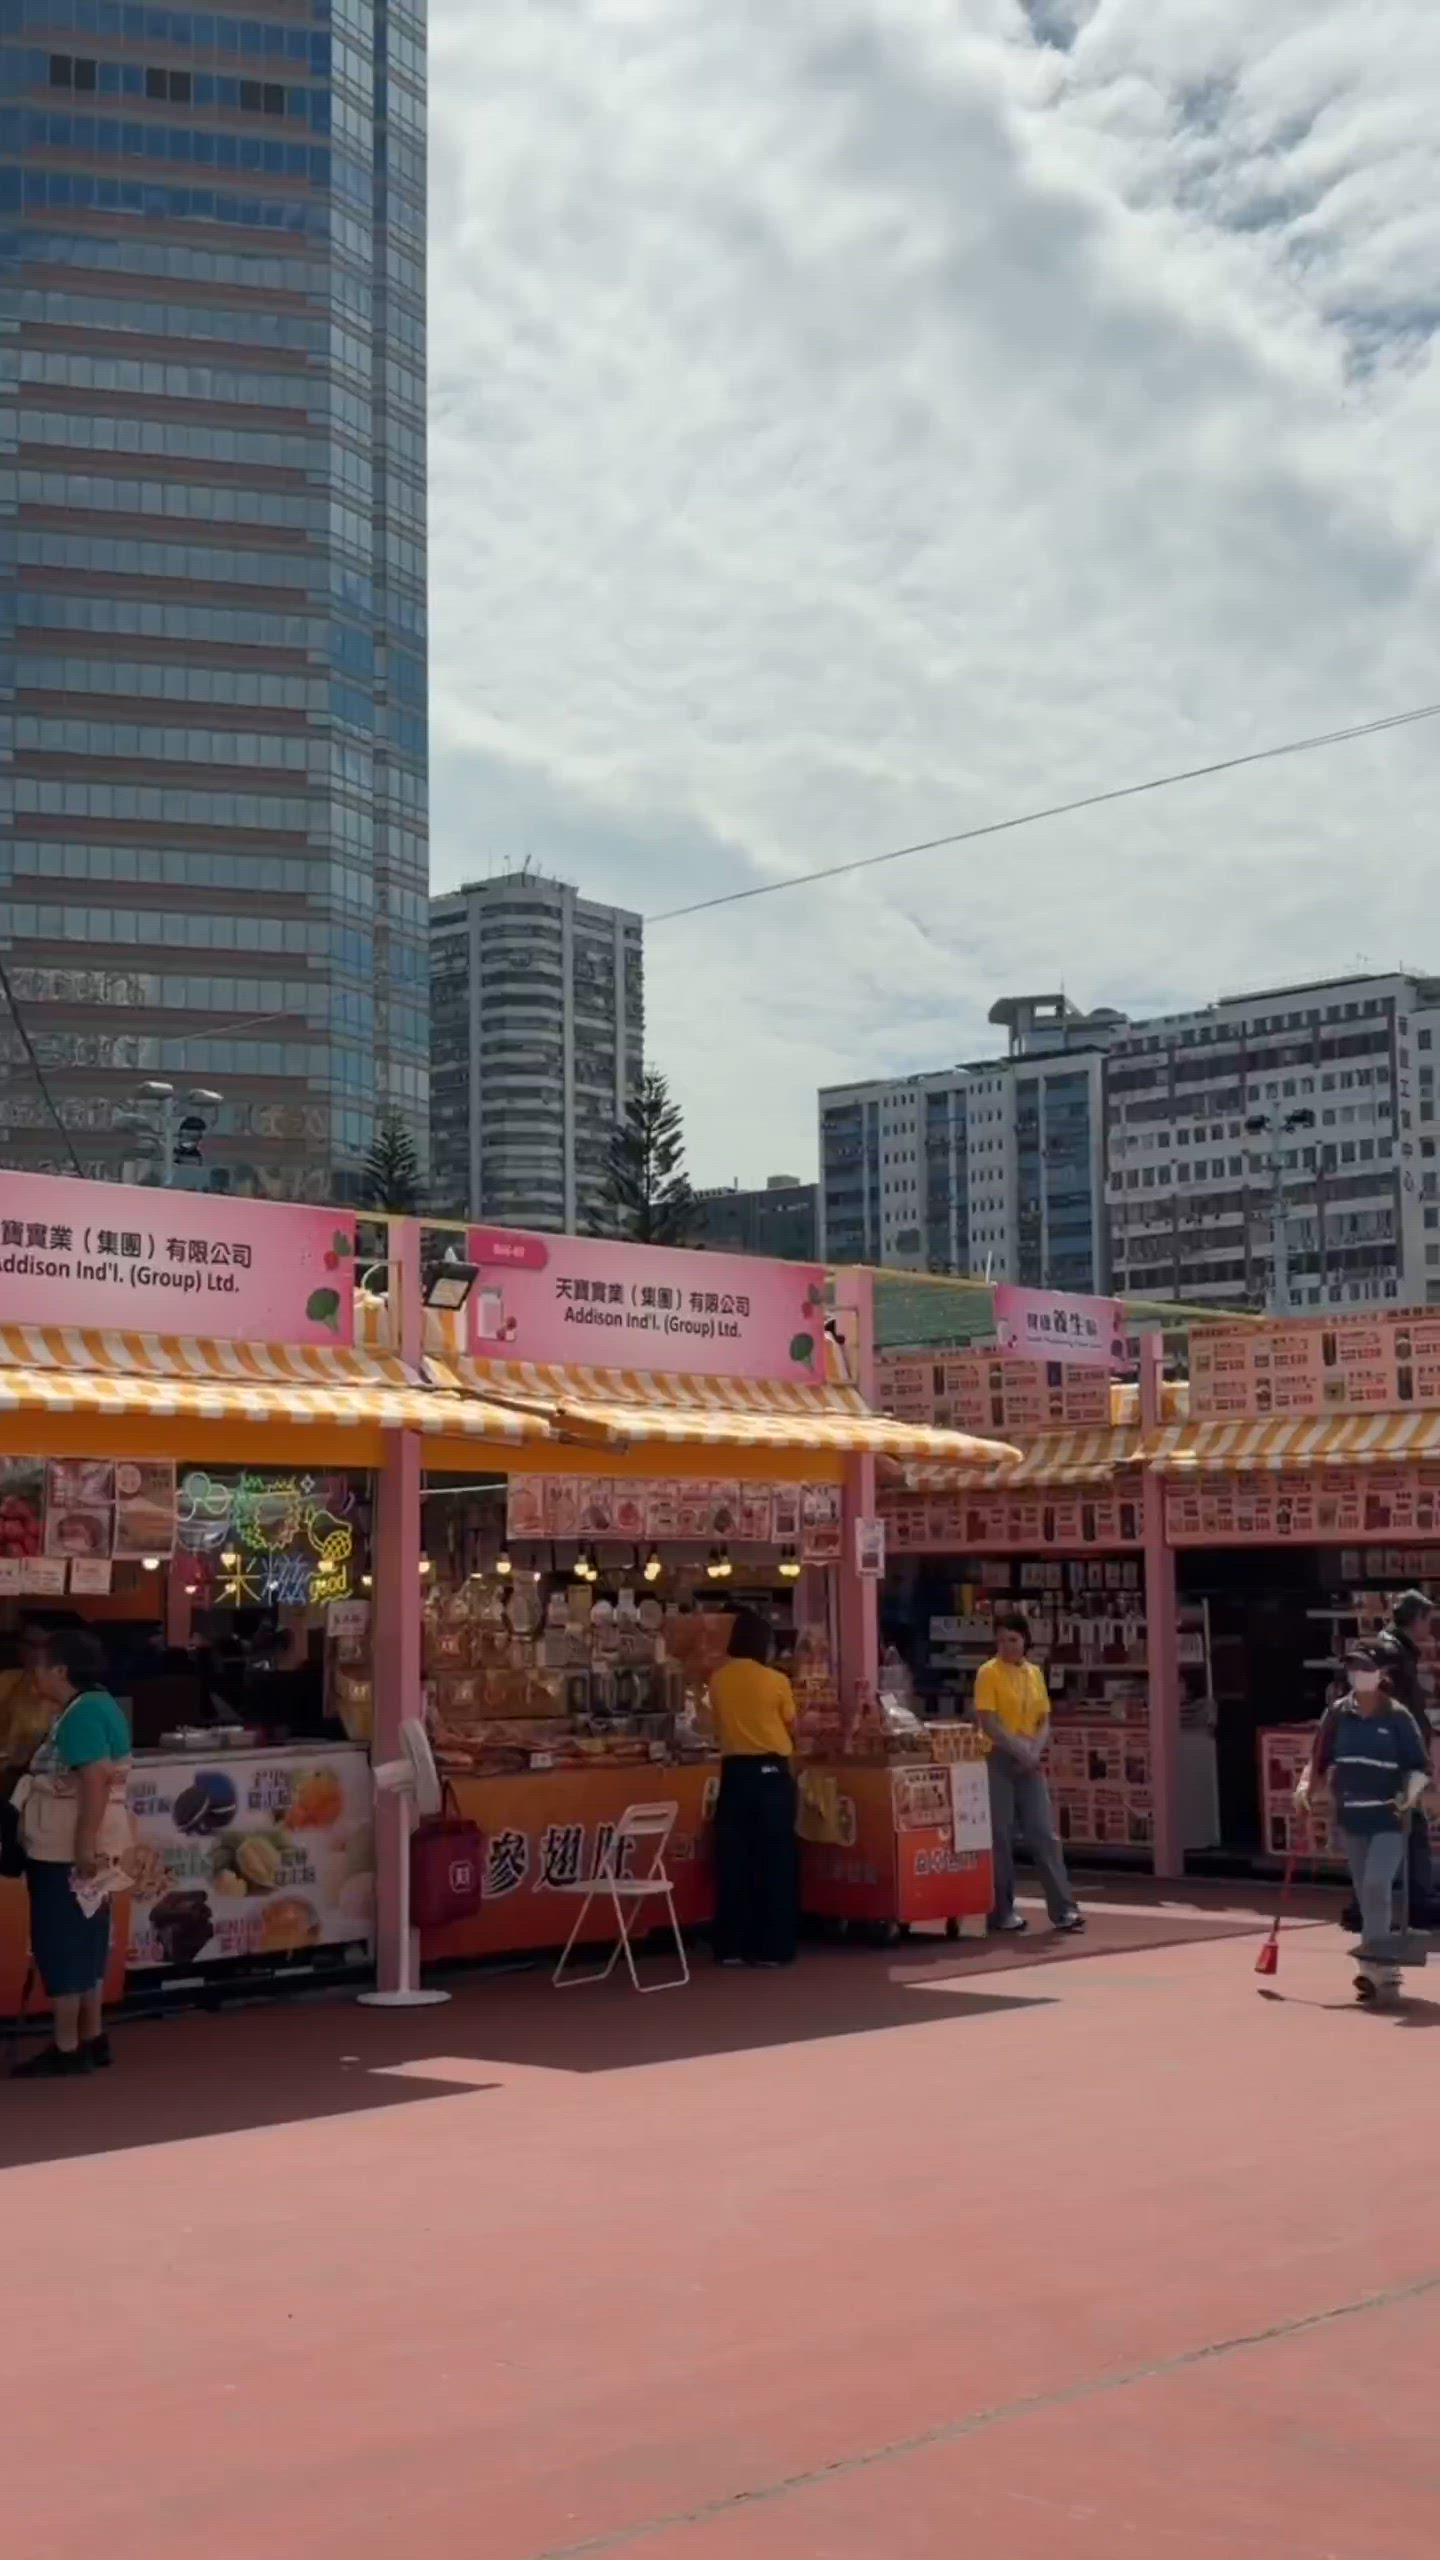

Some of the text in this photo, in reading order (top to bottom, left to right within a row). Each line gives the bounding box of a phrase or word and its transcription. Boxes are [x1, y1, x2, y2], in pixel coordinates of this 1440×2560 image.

[77, 1260, 124, 1283] Ind'l.
[130, 1264, 202, 1293] (Group)
[207, 1273, 240, 1294] Ltd.
[564, 1306, 742, 1339] Addison Ind'l. (Group) Ltd.
